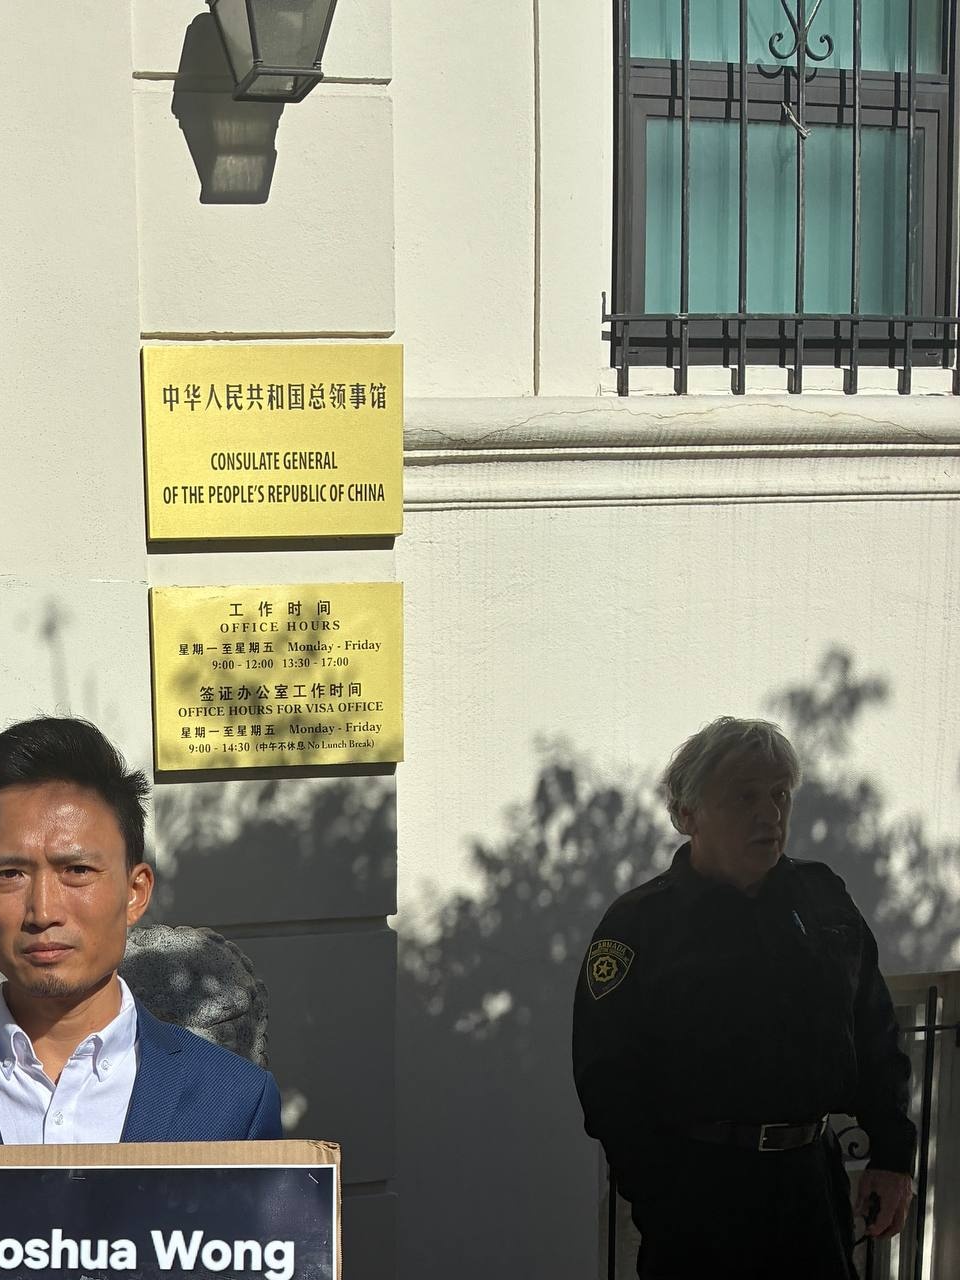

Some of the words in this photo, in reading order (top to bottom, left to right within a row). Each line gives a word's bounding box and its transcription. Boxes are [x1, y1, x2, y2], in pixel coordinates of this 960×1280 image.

[163, 382, 387, 412] 中华人民共和国总领事馆
[210, 451, 280, 471] CONSULATE
[283, 451, 338, 470] GENERAL
[163, 486, 178, 504] OF
[182, 486, 205, 504] THE
[208, 484, 265, 504] PEOPLE'S
[268, 484, 327, 503] REPUBLIC
[329, 484, 345, 502] OF
[347, 483, 385, 502] CHINA
[229, 600, 331, 617] 工作时间
[220, 622, 279, 634] OFFICE
[287, 620, 341, 632] HOURS
[178, 641, 275, 656] 星期一至星期五
[287, 641, 334, 653] Monday
[344, 640, 382, 653] Friday
[212, 659, 235, 670] 9:00
[246, 658, 274, 669] 12:00
[282, 658, 310, 668] 13:30
[321, 657, 349, 667] 17:00
[200, 682, 362, 702] 签证办公室工作时间
[178, 706, 225, 717] OFFICE
[229, 705, 273, 716] HOURS
[277, 704, 302, 714] FOR
[306, 703, 335, 713] VISA
[338, 701, 384, 712] OFFICE
[181, 724, 275, 739] 星期一至星期五
[289, 723, 335, 735] Monday
[345, 722, 382, 734] Friday
[188, 743, 211, 754] 9:00
[222, 742, 250, 753] 14:30
[307, 741, 320, 750] No
[321, 740, 347, 749] Lunch
[349, 739, 375, 749] Break)
